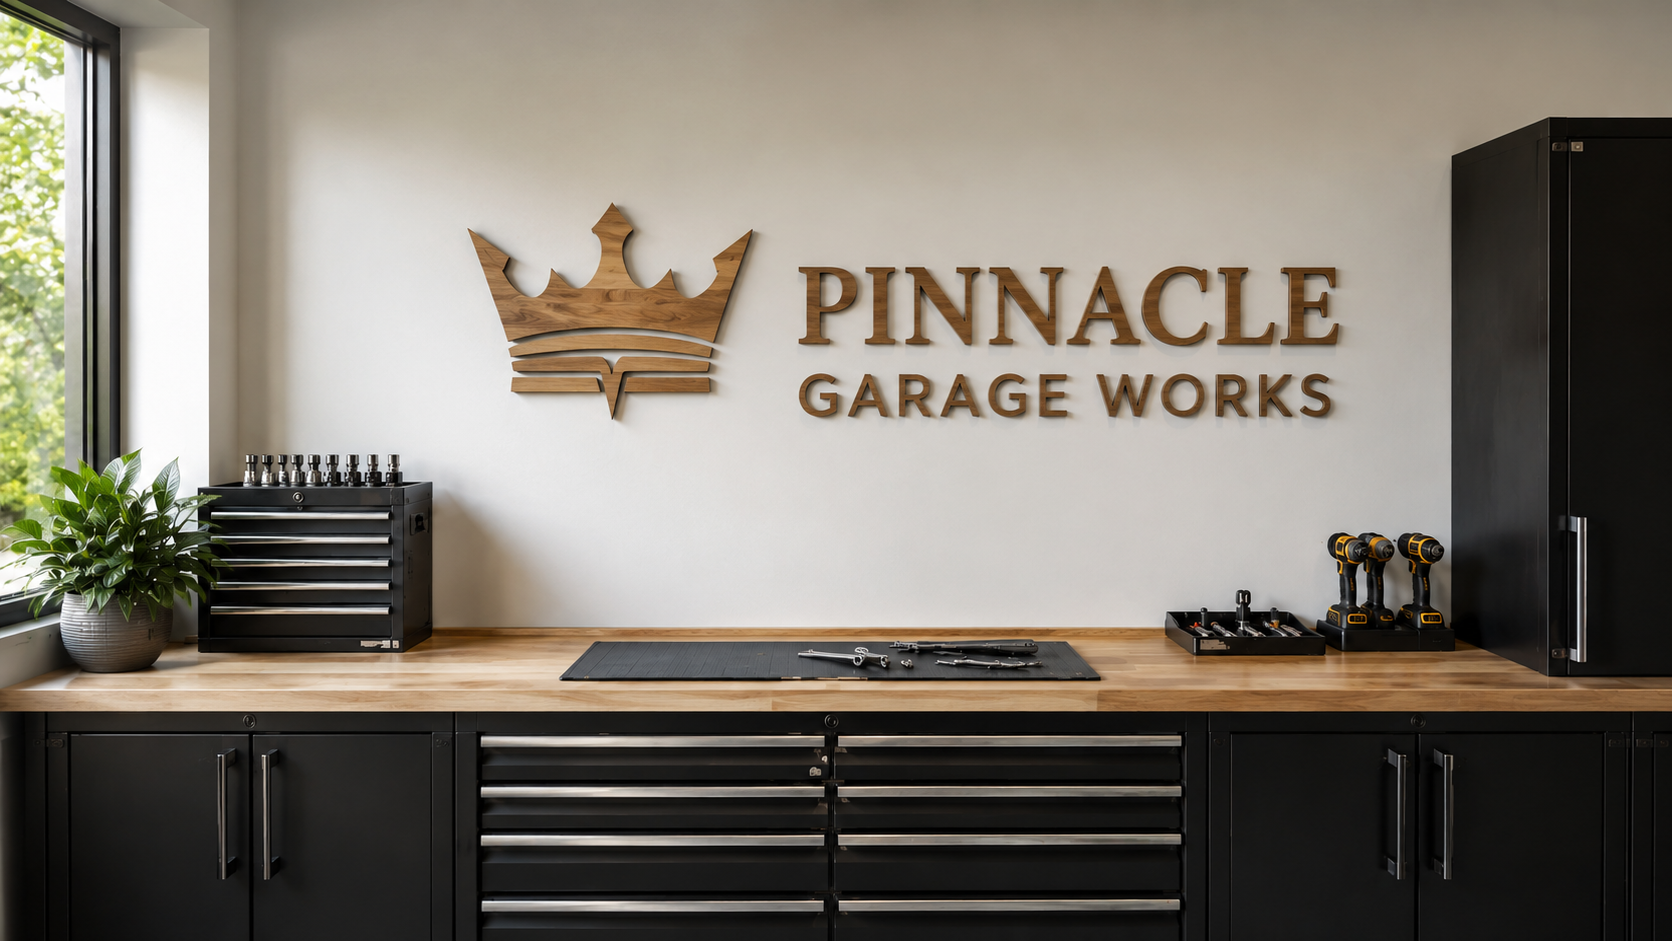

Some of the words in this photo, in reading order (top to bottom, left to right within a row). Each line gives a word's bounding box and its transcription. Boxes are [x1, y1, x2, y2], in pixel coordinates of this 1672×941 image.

[798, 265, 1340, 346] PINNACLE
[798, 373, 1069, 418] GARAGE
[1096, 373, 1333, 418] WORKS
